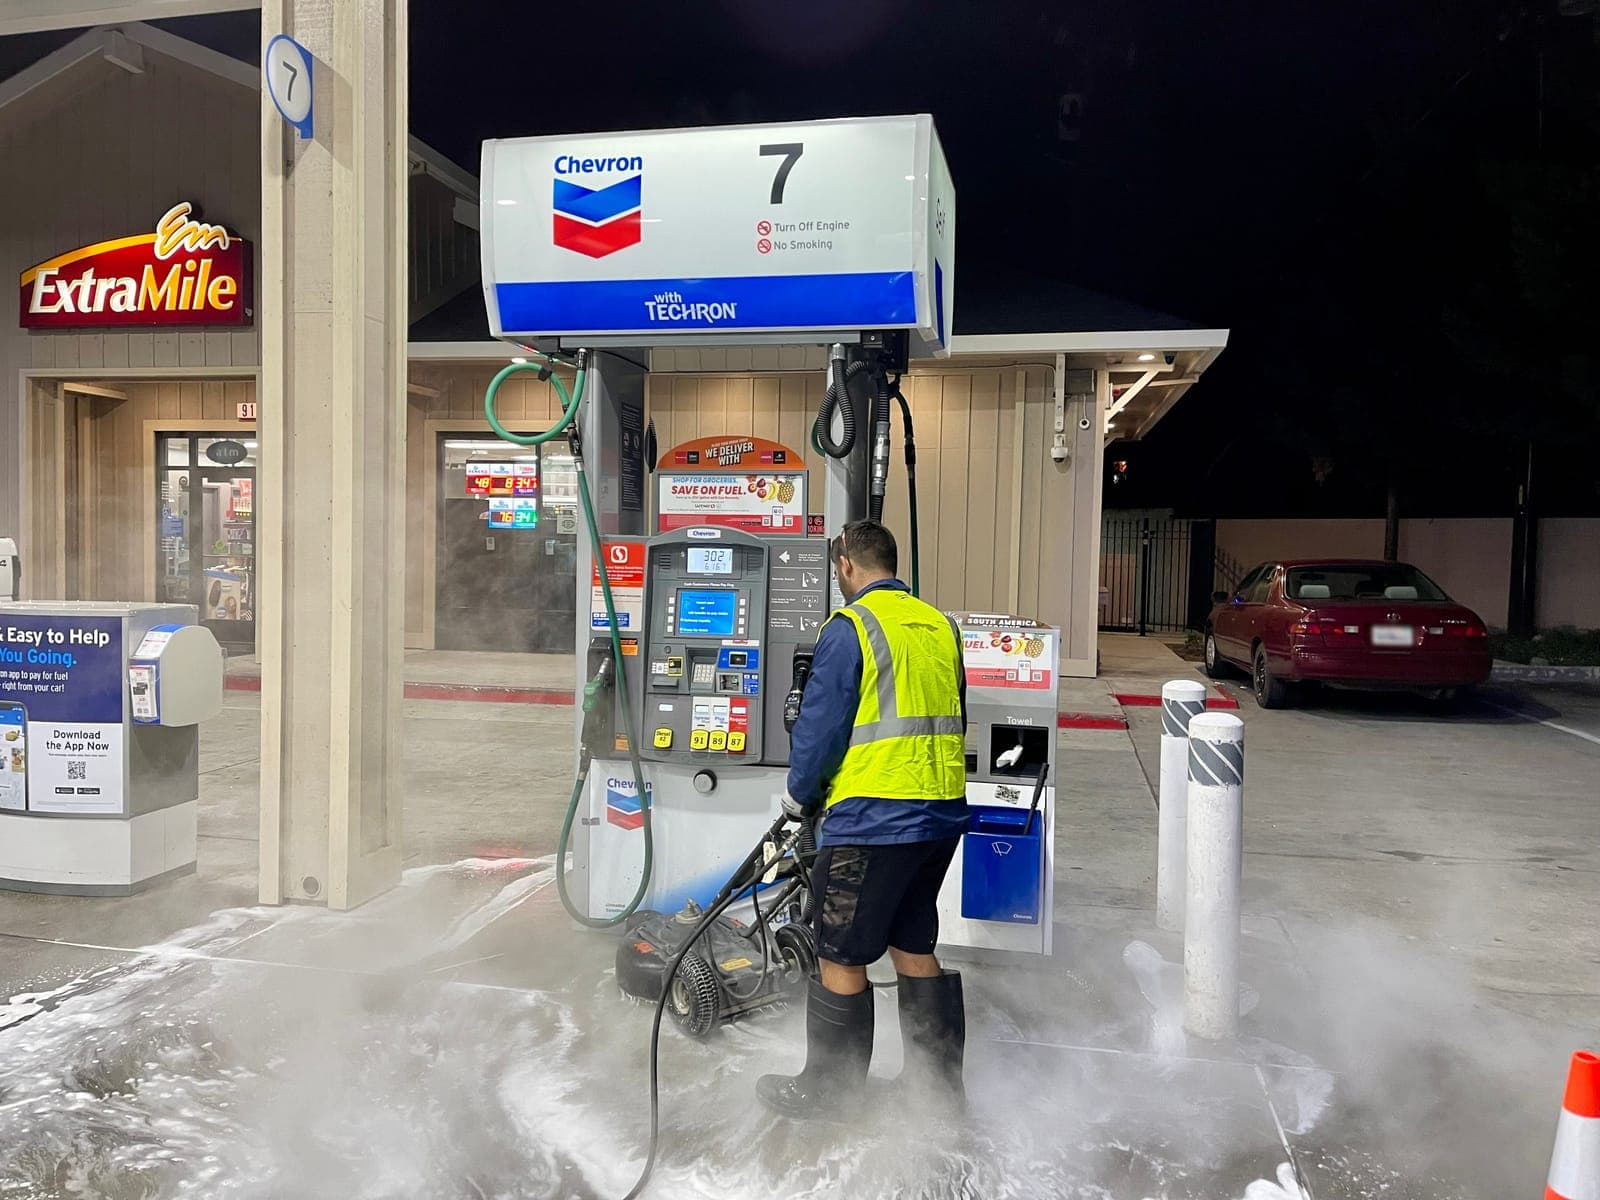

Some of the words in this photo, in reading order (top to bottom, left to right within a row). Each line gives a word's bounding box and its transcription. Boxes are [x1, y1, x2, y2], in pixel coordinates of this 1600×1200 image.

[281, 60, 298, 102] 7
[553, 154, 643, 175] Chevron
[758, 142, 804, 205] 7
[154, 201, 230, 260] Em
[774, 221, 796, 234] Turn
[798, 220, 814, 233] Off
[816, 219, 850, 234] Engine
[774, 240, 787, 251] No
[788, 238, 833, 252] Smoking
[28, 258, 238, 315] ExtraMile
[654, 291, 683, 304] with
[645, 301, 737, 323] TECHRON
[215, 447, 239, 457] atm
[705, 448, 719, 459] WE
[719, 442, 754, 456] DELIVER
[718, 453, 741, 467] WITH
[475, 477, 490, 489] 48
[505, 477, 514, 489] 8
[671, 485, 699, 495] SAVE
[700, 485, 717, 495] ON
[719, 486, 747, 495] FUEL.
[967, 618, 996, 626] SOUTH
[998, 619, 1037, 627] AMERICA
[7, 627, 42, 647] Easy
[47, 628, 65, 644] to
[69, 629, 110, 648] Help
[965, 641, 989, 649] UEL.
[0, 647, 23, 662] You
[27, 648, 77, 668] Going.
[9, 671, 20, 680] app
[21, 670, 28, 679] to
[29, 672, 41, 681] pay
[42, 671, 52, 680] for
[54, 671, 69, 681] fuel
[2, 681, 16, 692] right
[17, 682, 33, 691] from
[34, 684, 49, 693] your
[50, 683, 65, 693] car!
[1006, 716, 1033, 726] Towel
[53, 729, 101, 739] Download
[46, 741, 61, 750] the
[64, 742, 84, 752] App
[87, 742, 109, 751] Now
[694, 736, 704, 745] 91
[712, 737, 723, 746] 89
[730, 738, 742, 747] 87
[607, 778, 652, 790] Chevrn
